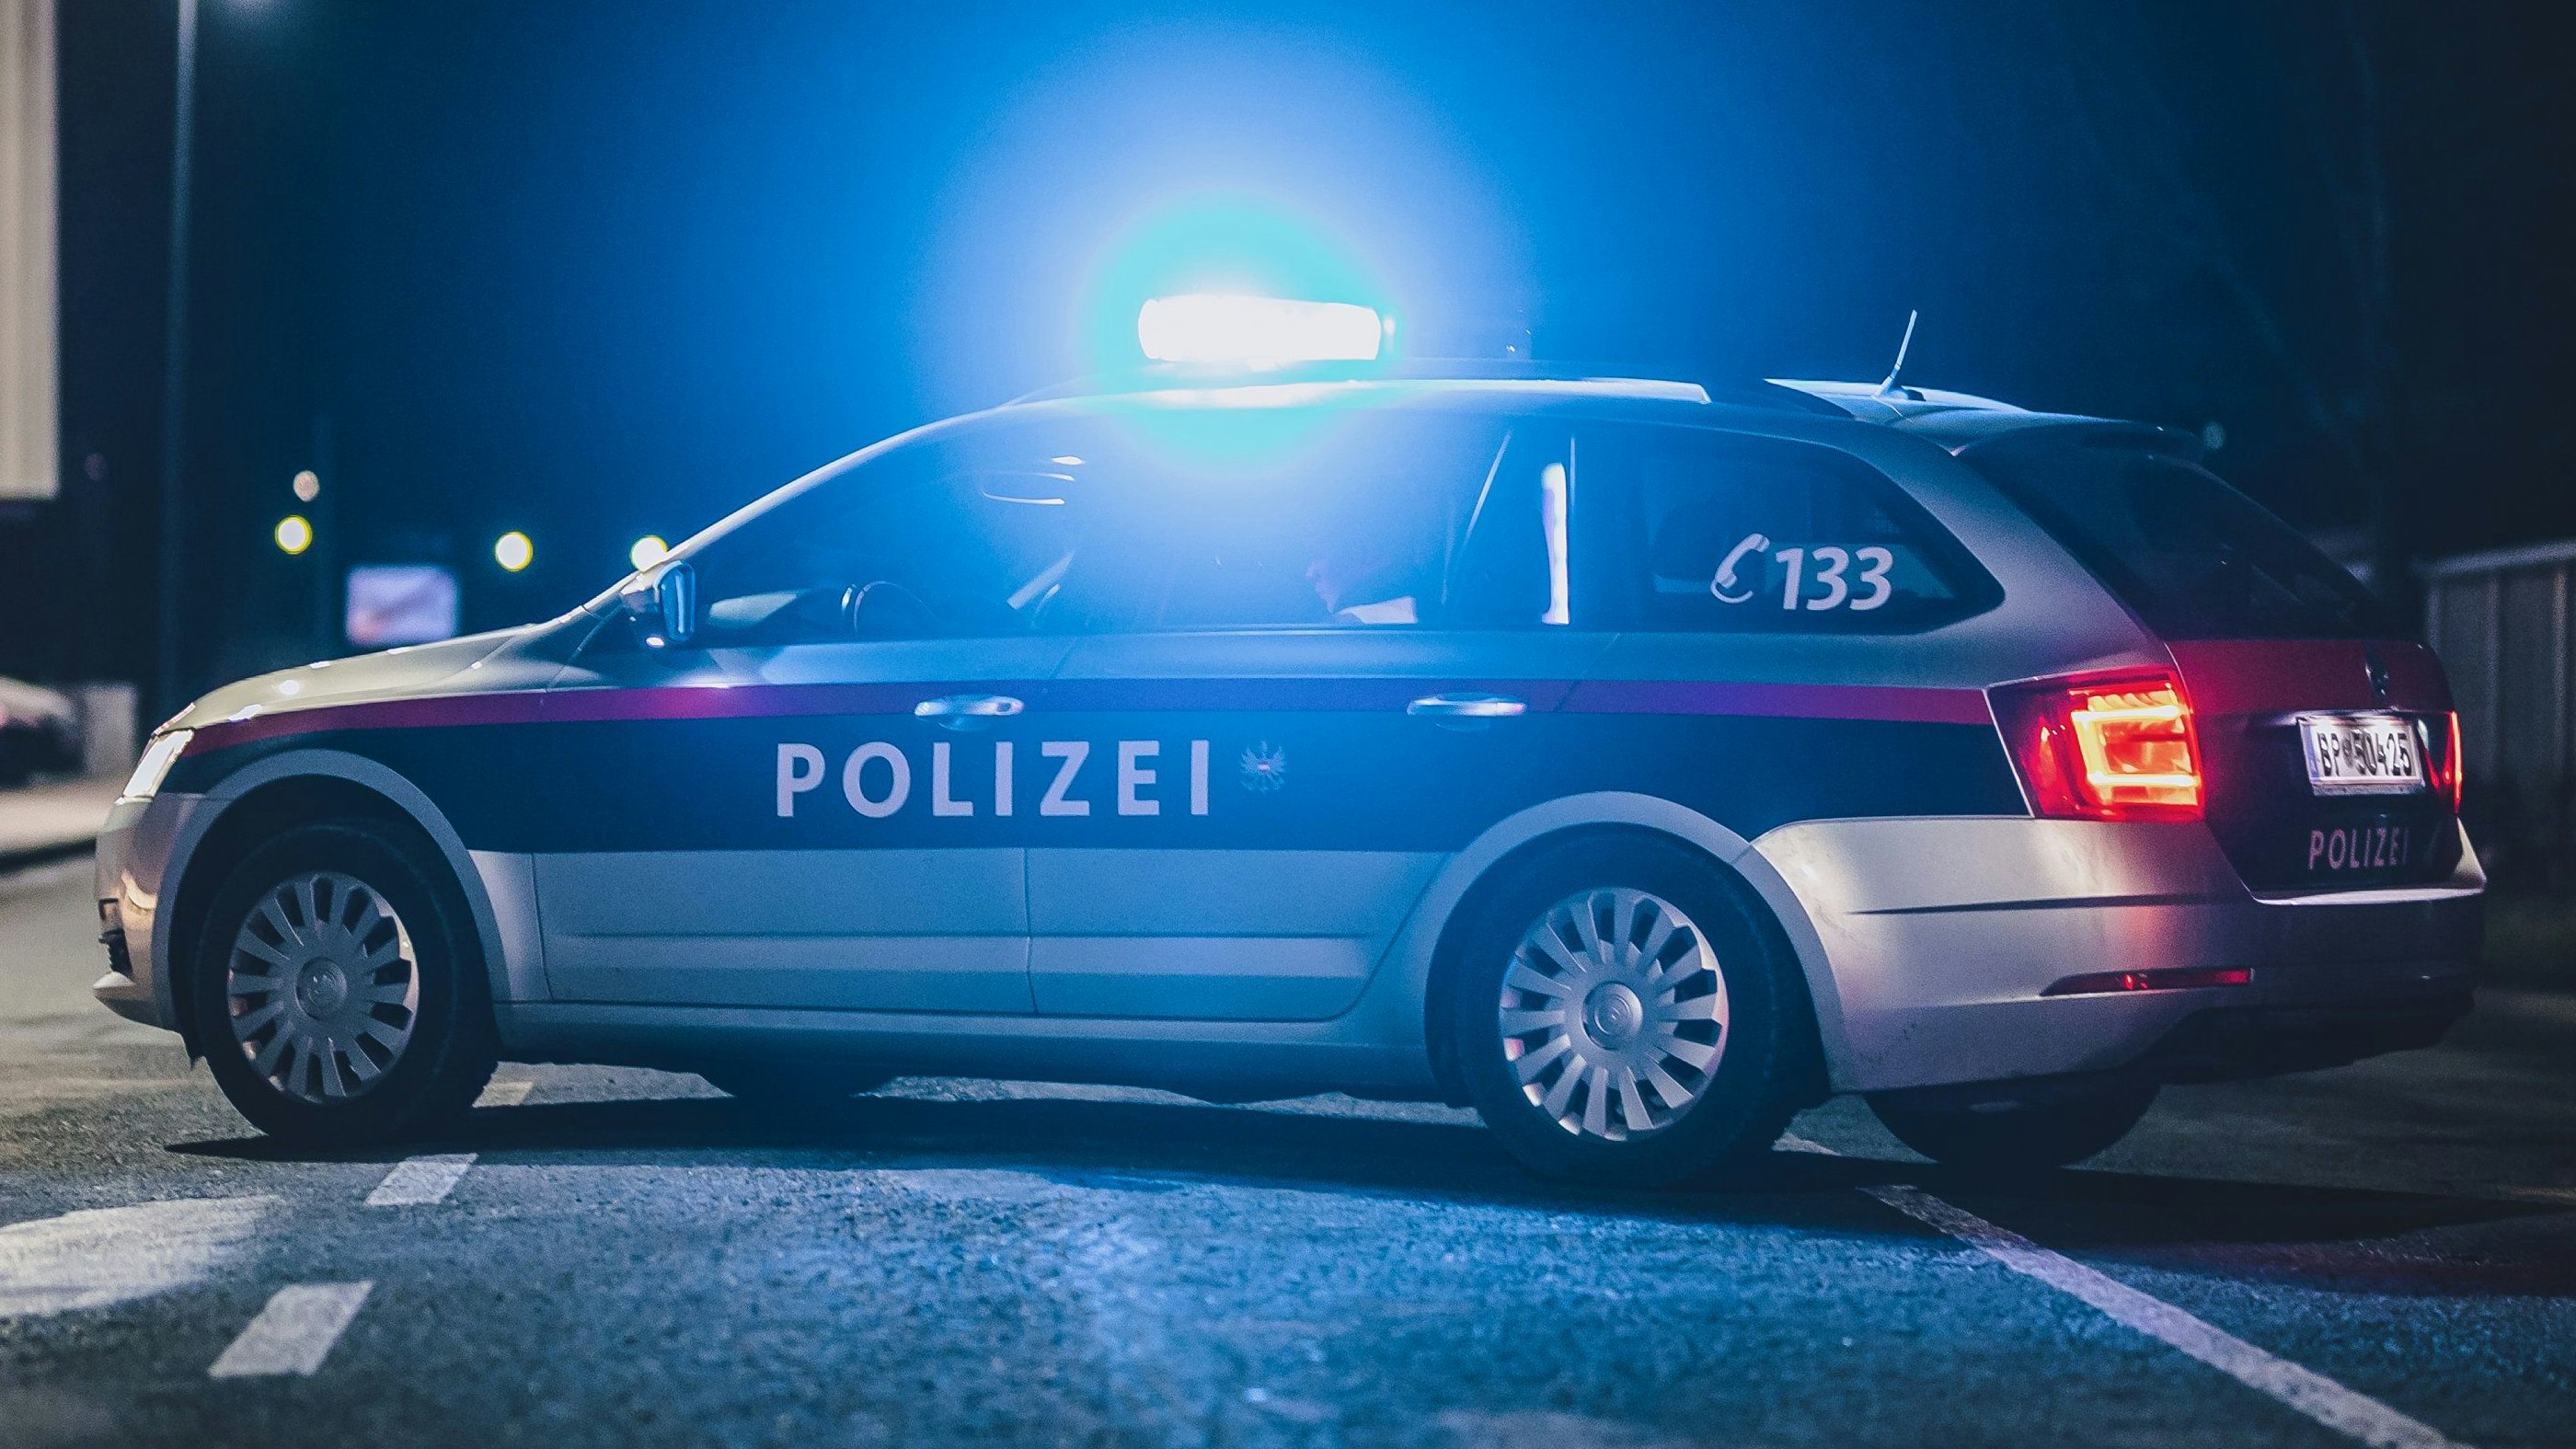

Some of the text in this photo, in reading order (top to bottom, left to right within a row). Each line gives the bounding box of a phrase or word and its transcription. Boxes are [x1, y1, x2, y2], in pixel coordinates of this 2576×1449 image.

[1776, 546, 1893, 611] 133
[776, 739, 1210, 818] POLIZEI
[2308, 827, 2409, 869] POLIZEI
